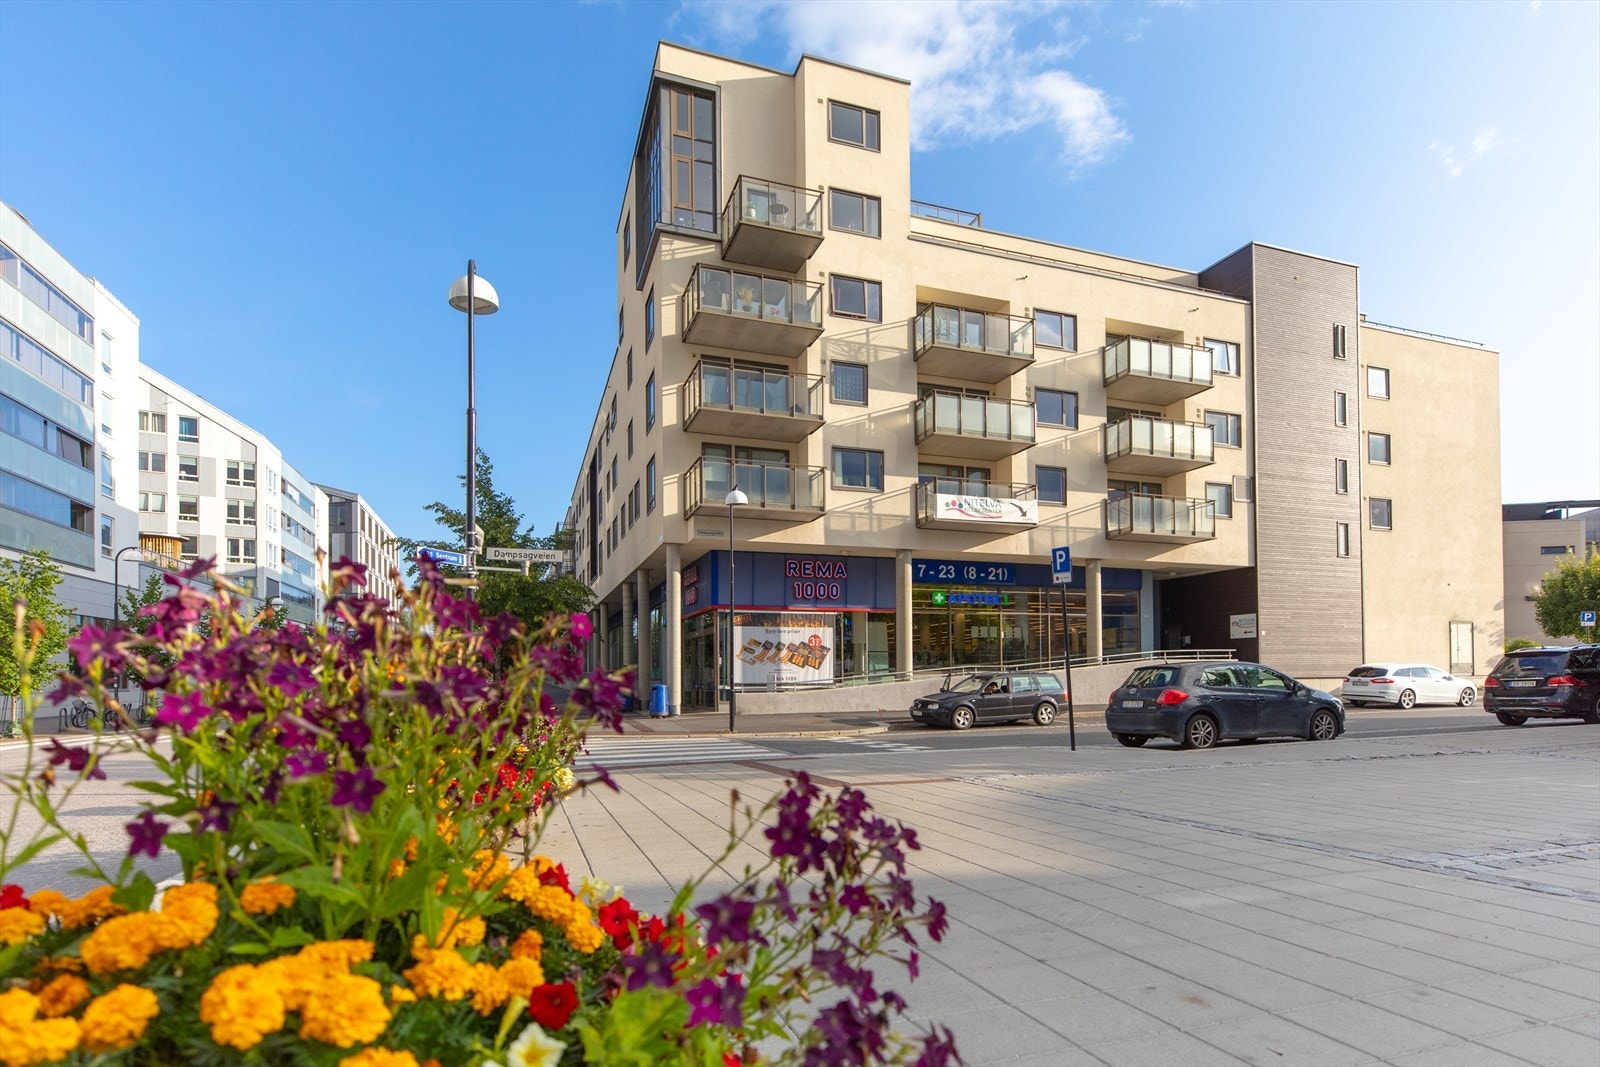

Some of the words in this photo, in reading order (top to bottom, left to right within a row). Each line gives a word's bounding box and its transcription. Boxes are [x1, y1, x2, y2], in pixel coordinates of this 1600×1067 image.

[963, 497, 1002, 509] NITELVA
[435, 551, 458, 562] Sentrum
[494, 549, 556, 561] Dampsagveien
[1055, 550, 1066, 571] P
[785, 559, 848, 579] REMA
[917, 564, 927, 578] 7
[938, 565, 956, 579] 23
[963, 566, 977, 580] (8
[987, 567, 1008, 581] 21)
[794, 582, 841, 600] 1000
[948, 592, 1001, 605] APOTEK
[1584, 612, 1593, 621] P
